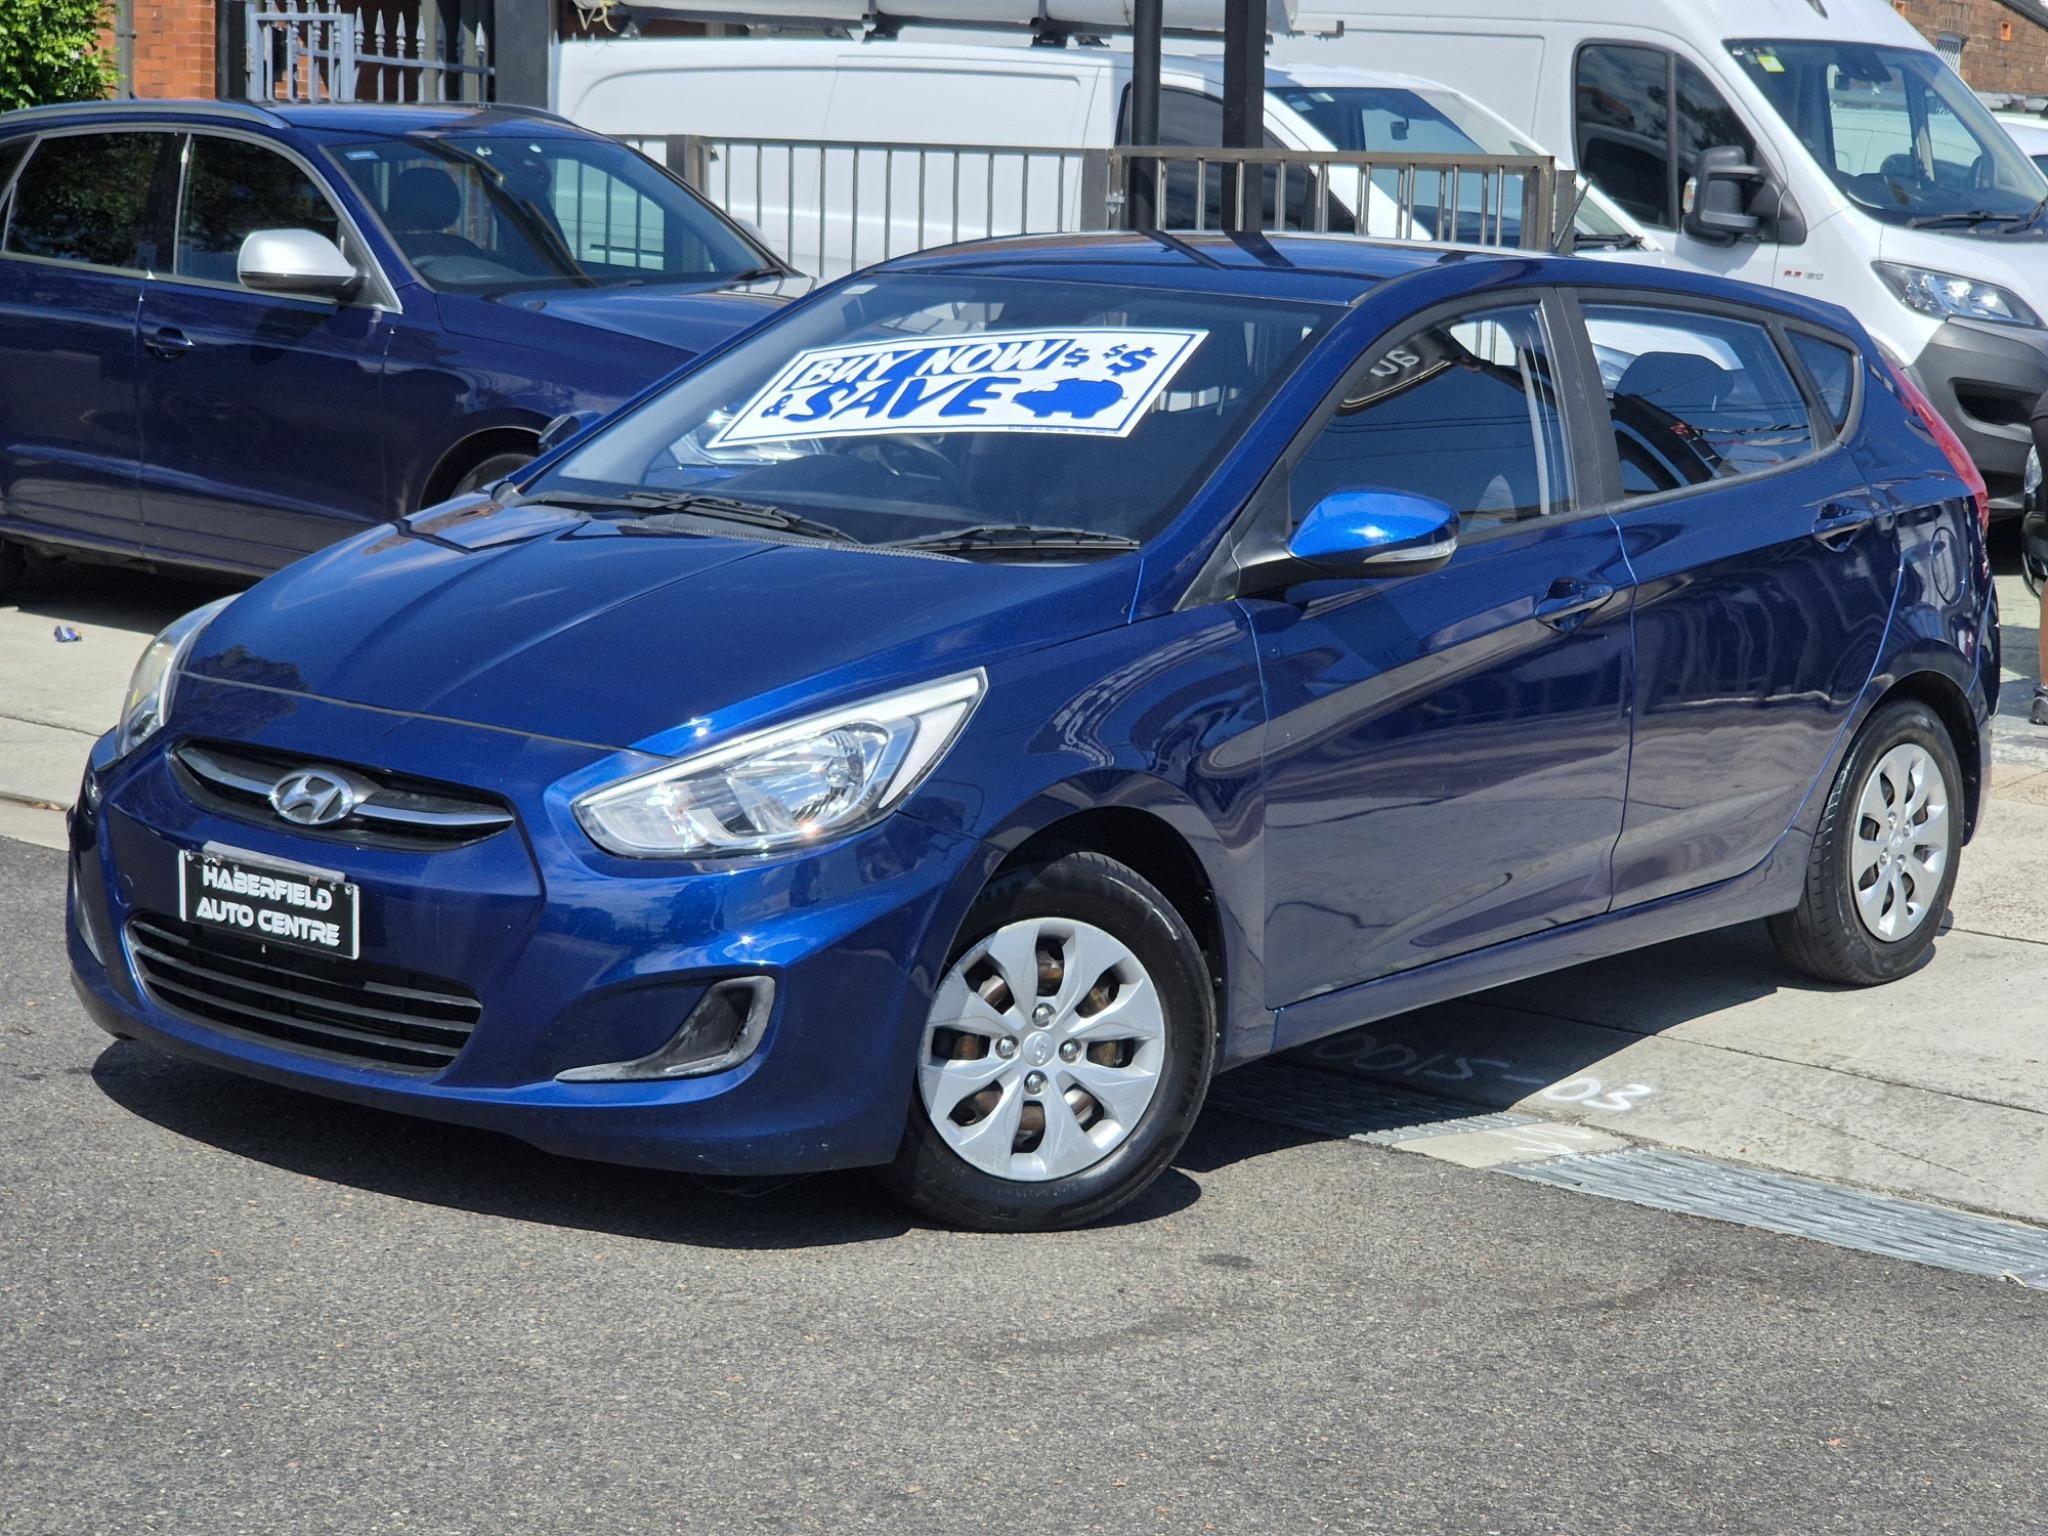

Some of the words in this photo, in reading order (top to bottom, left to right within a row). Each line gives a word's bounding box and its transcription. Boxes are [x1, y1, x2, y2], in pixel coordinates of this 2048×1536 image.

[790, 349, 925, 389] BUY
[914, 338, 1074, 377] NOW
[760, 393, 794, 418] &
[783, 376, 1022, 423] SAVE
[202, 864, 333, 912] HABERFIELD
[196, 896, 255, 928] AUTO
[257, 908, 341, 947] CENTRE
